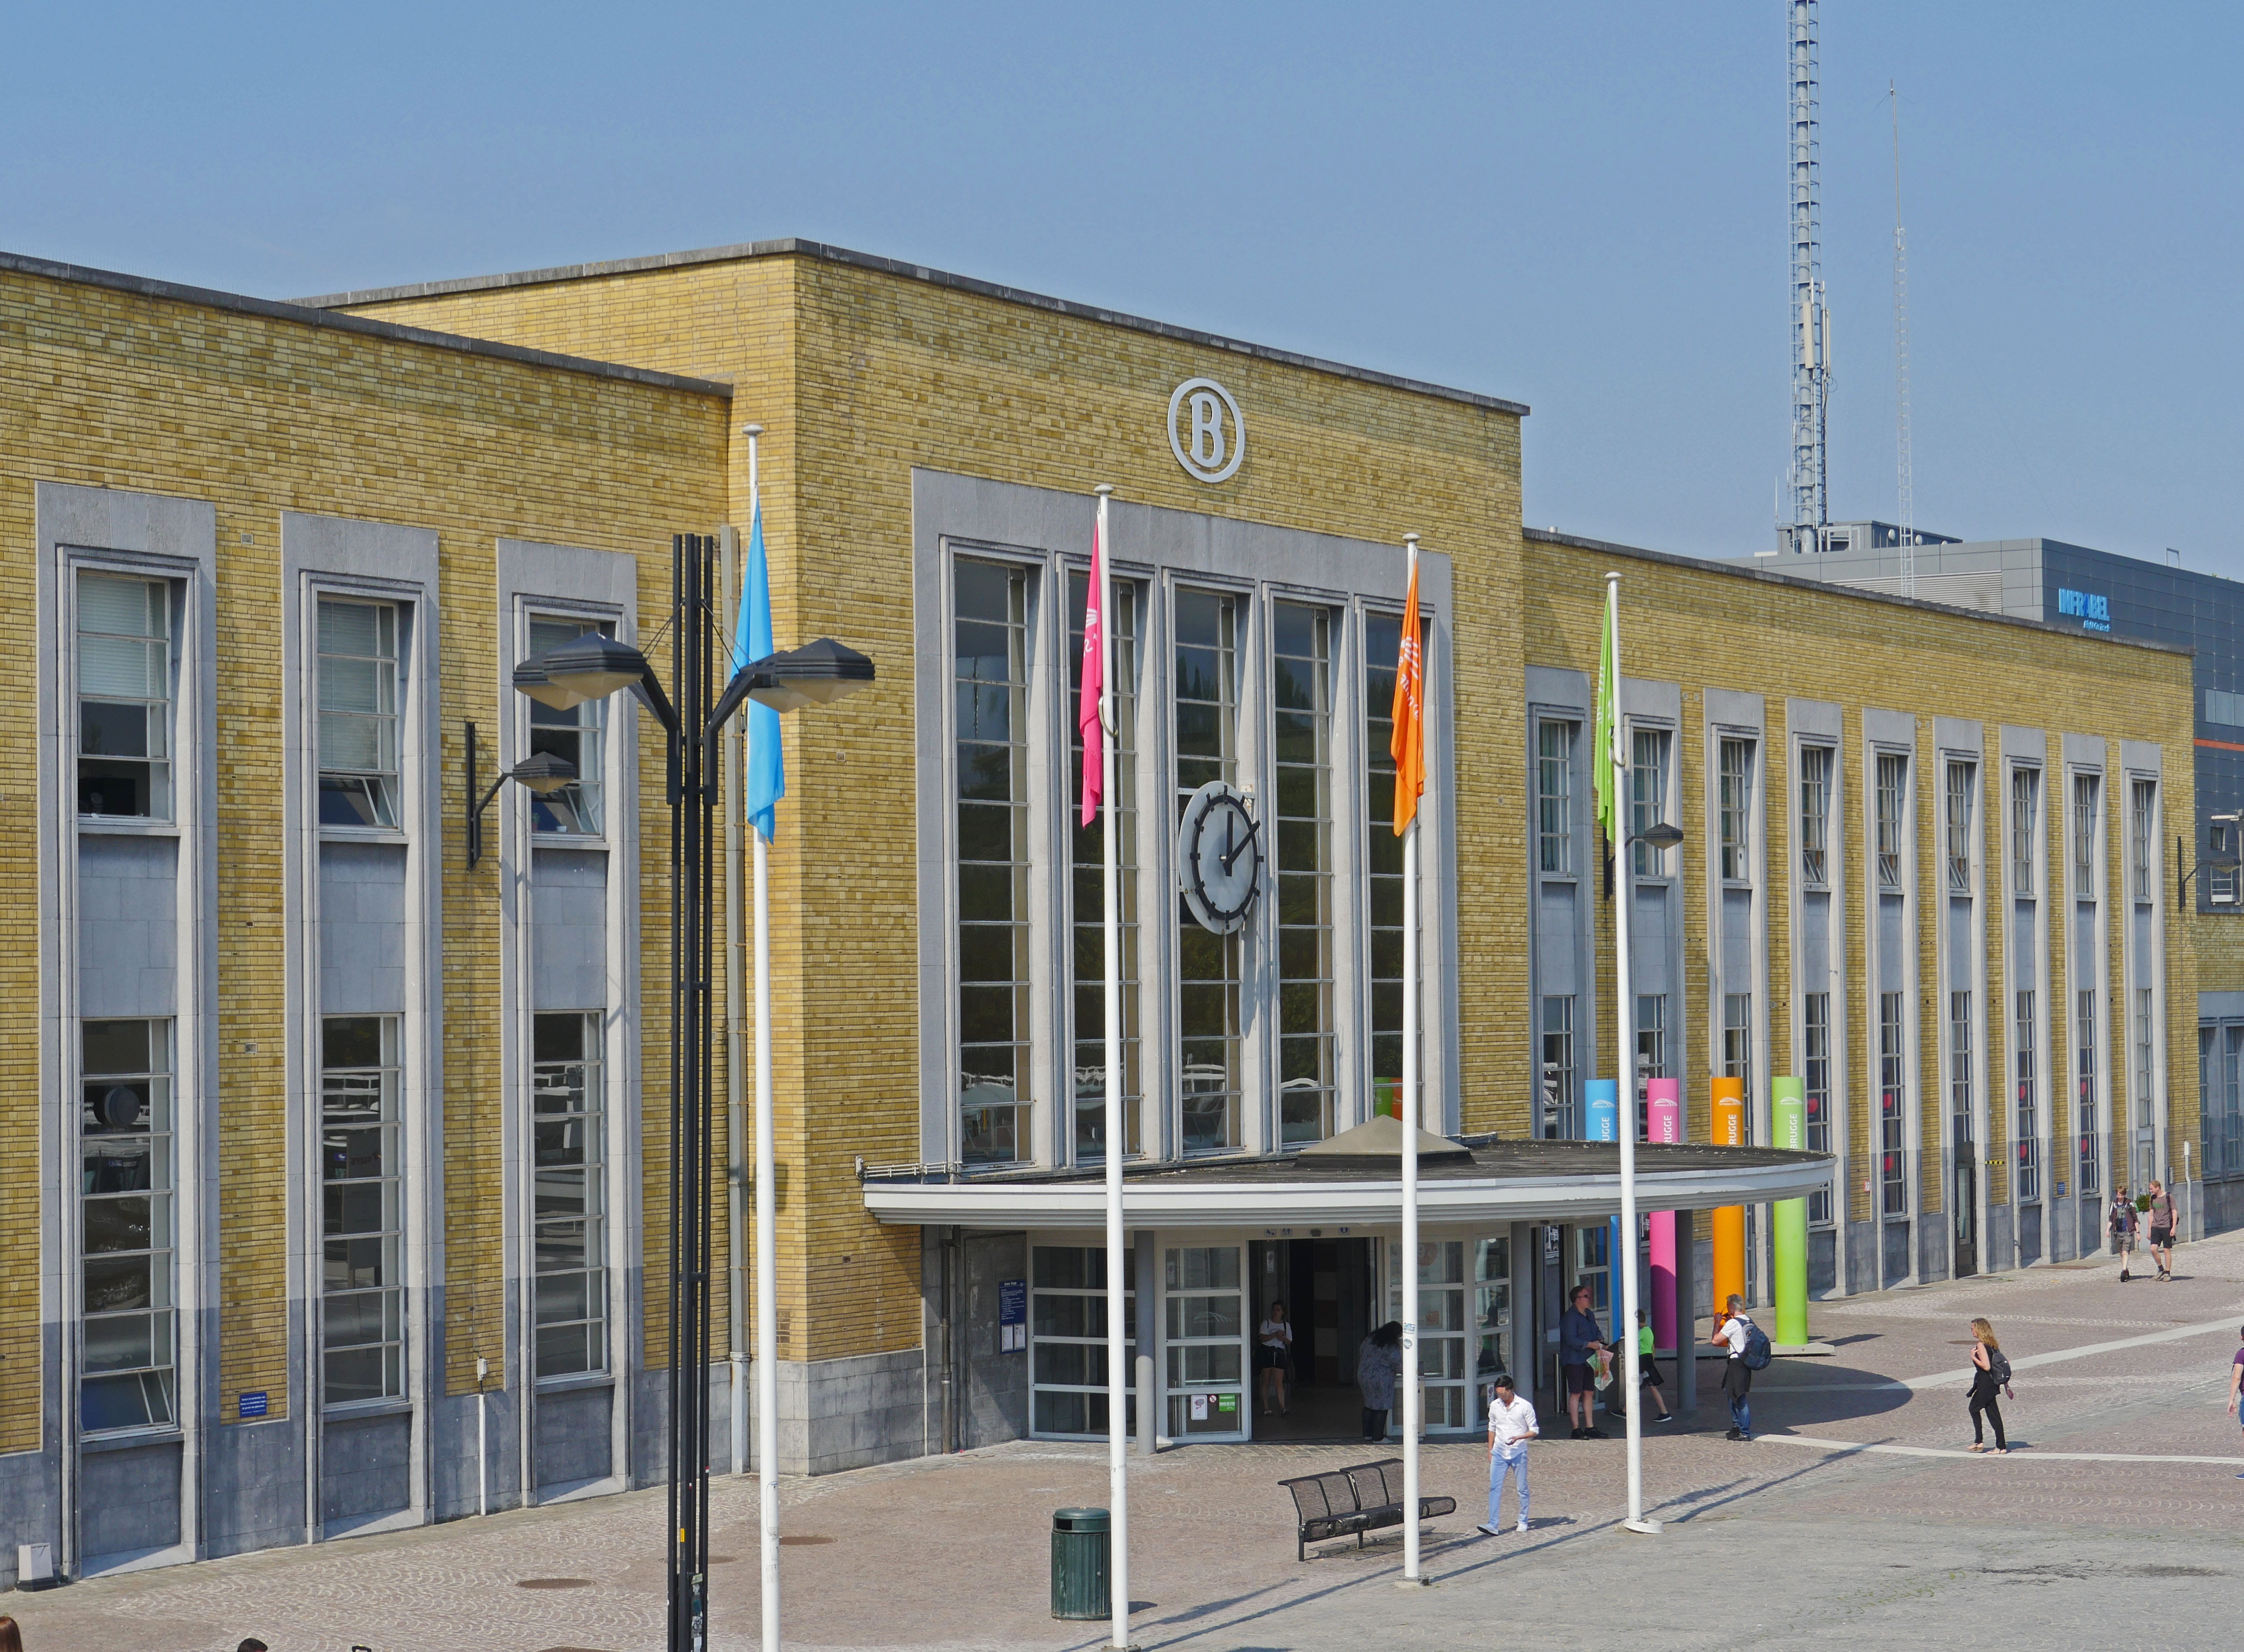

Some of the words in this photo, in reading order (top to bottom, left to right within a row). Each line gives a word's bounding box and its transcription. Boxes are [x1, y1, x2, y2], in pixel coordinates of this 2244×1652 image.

[1189, 392, 1224, 467] B
[2059, 588, 2110, 621] INFRABEL
[1789, 1113, 1798, 1149] BRUGGE
